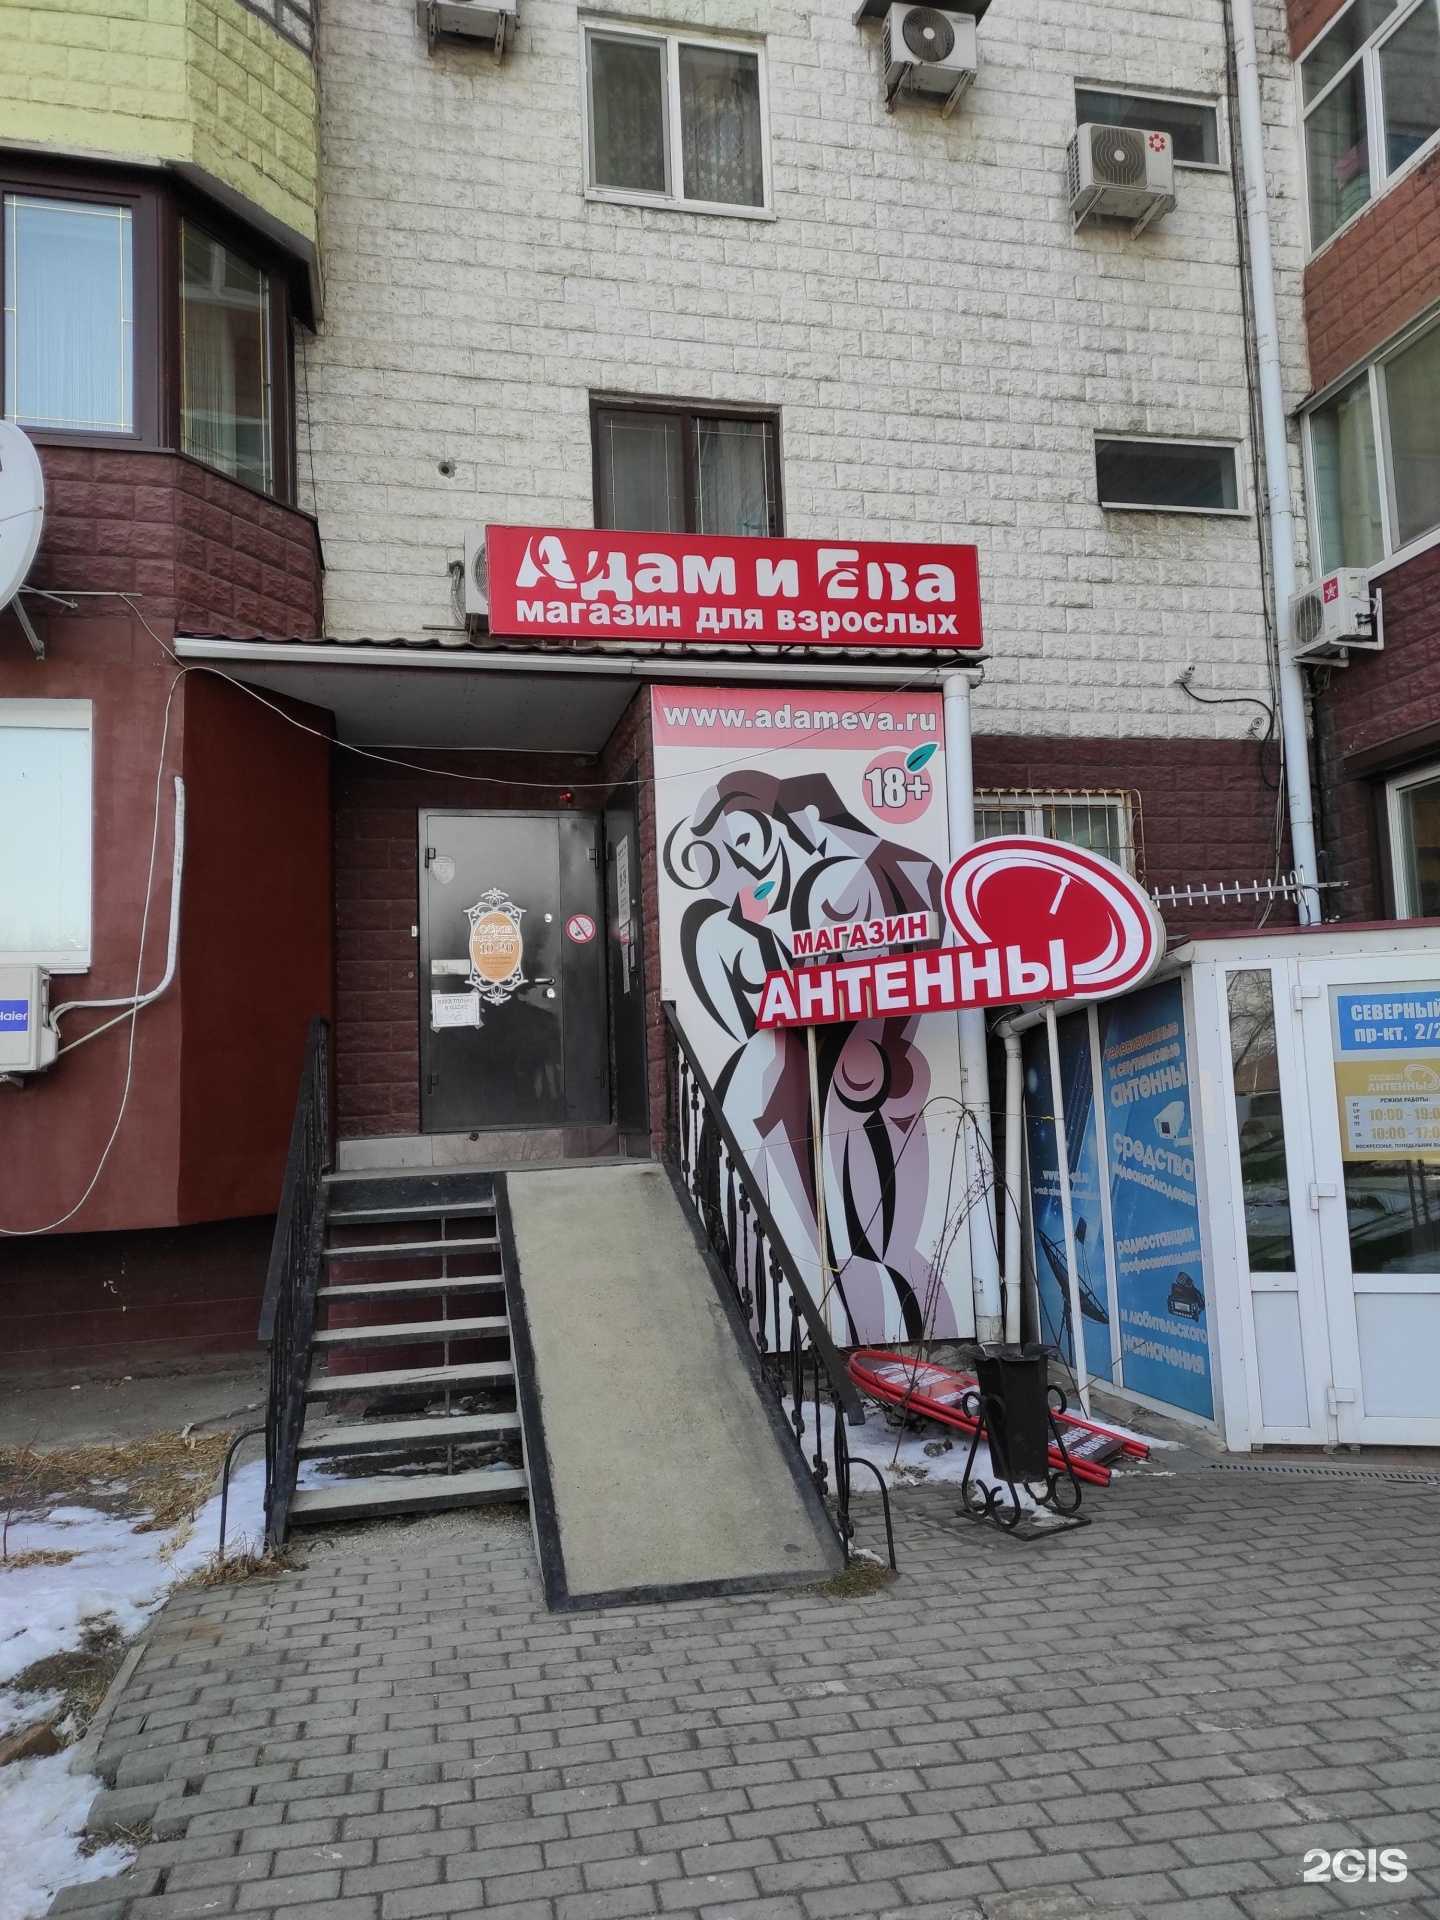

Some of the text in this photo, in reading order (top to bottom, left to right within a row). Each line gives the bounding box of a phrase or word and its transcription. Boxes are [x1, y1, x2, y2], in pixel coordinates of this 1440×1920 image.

[515, 534, 956, 603] Адам и Ева
[516, 599, 959, 639] магазин для взрослых
[663, 703, 937, 732] www.adameva.ru
[864, 766, 930, 809] 18+
[792, 914, 928, 956] МАГАЗИН
[760, 939, 1068, 1023] АНТЕННЫ
